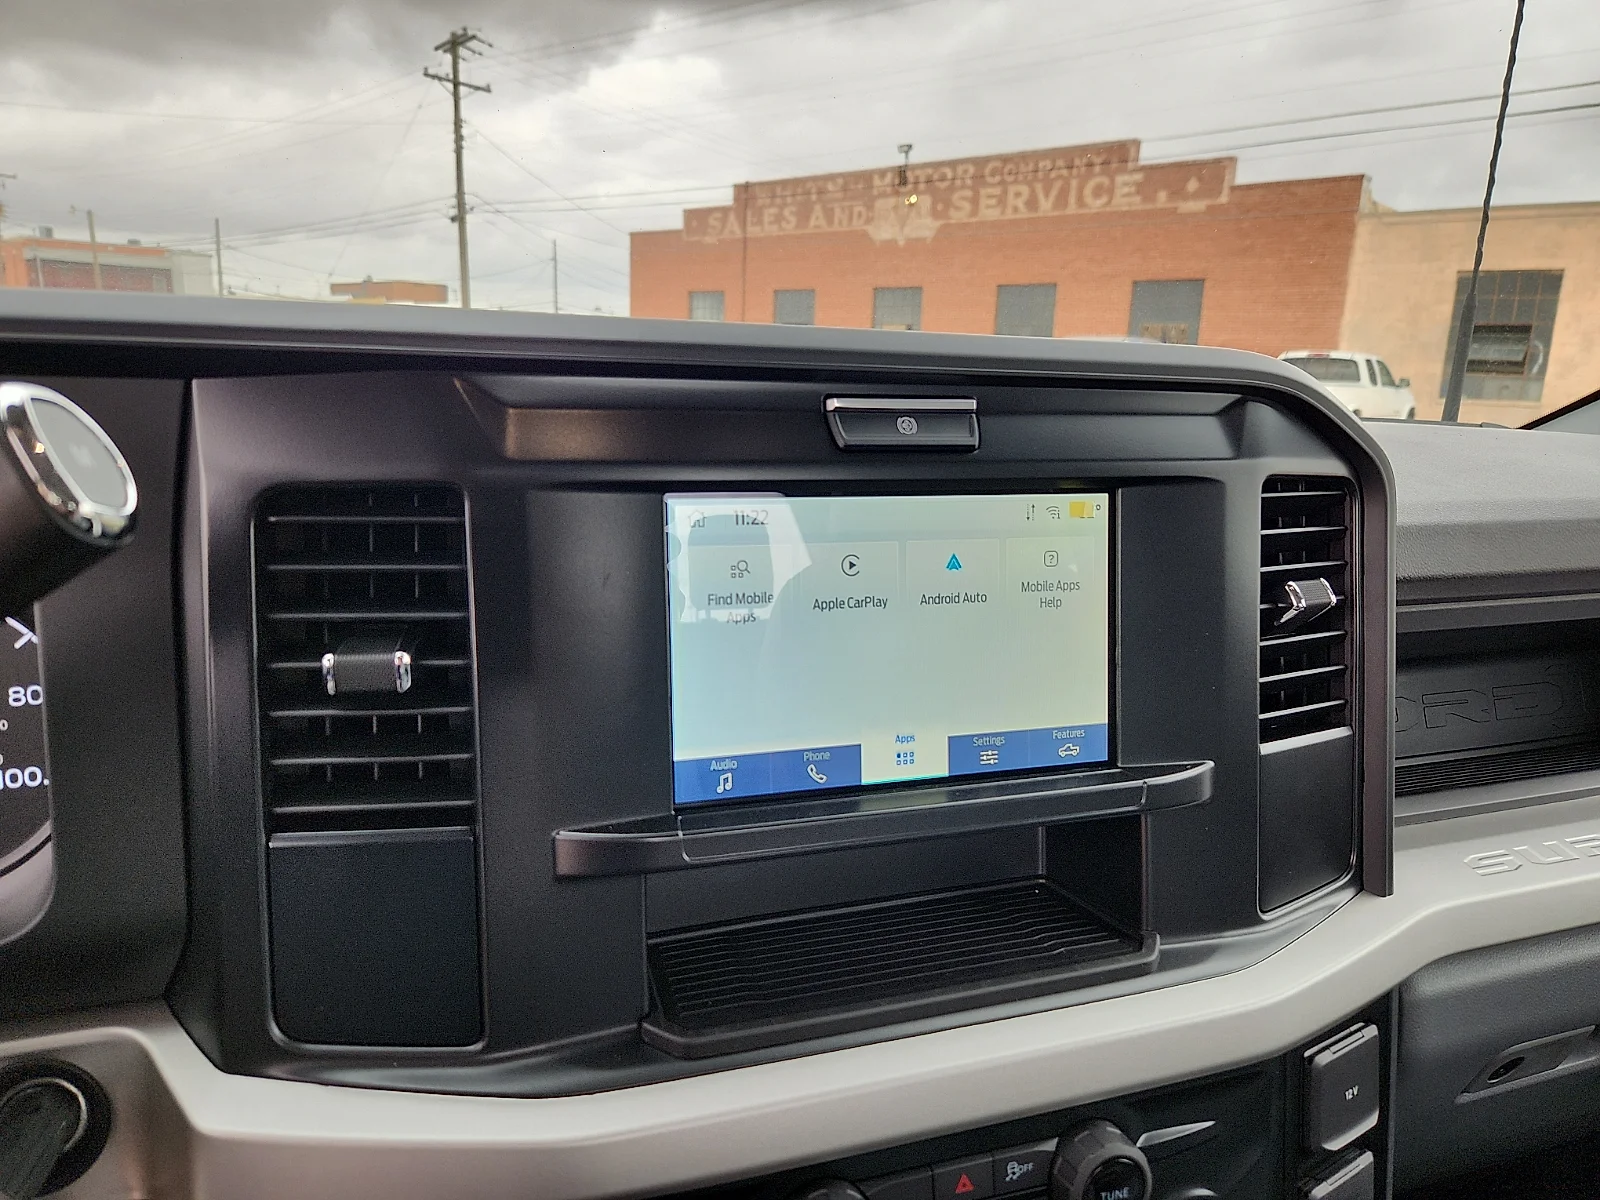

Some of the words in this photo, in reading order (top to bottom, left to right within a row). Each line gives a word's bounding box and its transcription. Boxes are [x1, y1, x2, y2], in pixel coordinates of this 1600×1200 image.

[872, 163, 975, 195] MOTOR
[706, 204, 799, 241] SALES
[809, 202, 868, 230] AND
[948, 171, 1145, 221] SERVICE
[734, 509, 769, 526] 11:22
[1020, 580, 1054, 593] Mobile
[1056, 579, 1081, 593] Apps
[707, 593, 733, 606] Find
[735, 591, 774, 605] Mobile
[812, 599, 845, 611] Apple
[847, 596, 888, 610] CarPlay
[920, 593, 960, 606] Android
[962, 592, 988, 604] Auto
[1039, 597, 1062, 609] Help
[726, 611, 757, 625] Apps
[8, 685, 43, 707] 80
[895, 734, 916, 745] Apps
[972, 735, 1005, 746] Settings
[1052, 729, 1085, 740] Features
[803, 751, 831, 762] Phone
[709, 759, 738, 772] Audio
[1018, 1162, 1034, 1174] OFF
[1100, 1187, 1130, 1200] TUNE
